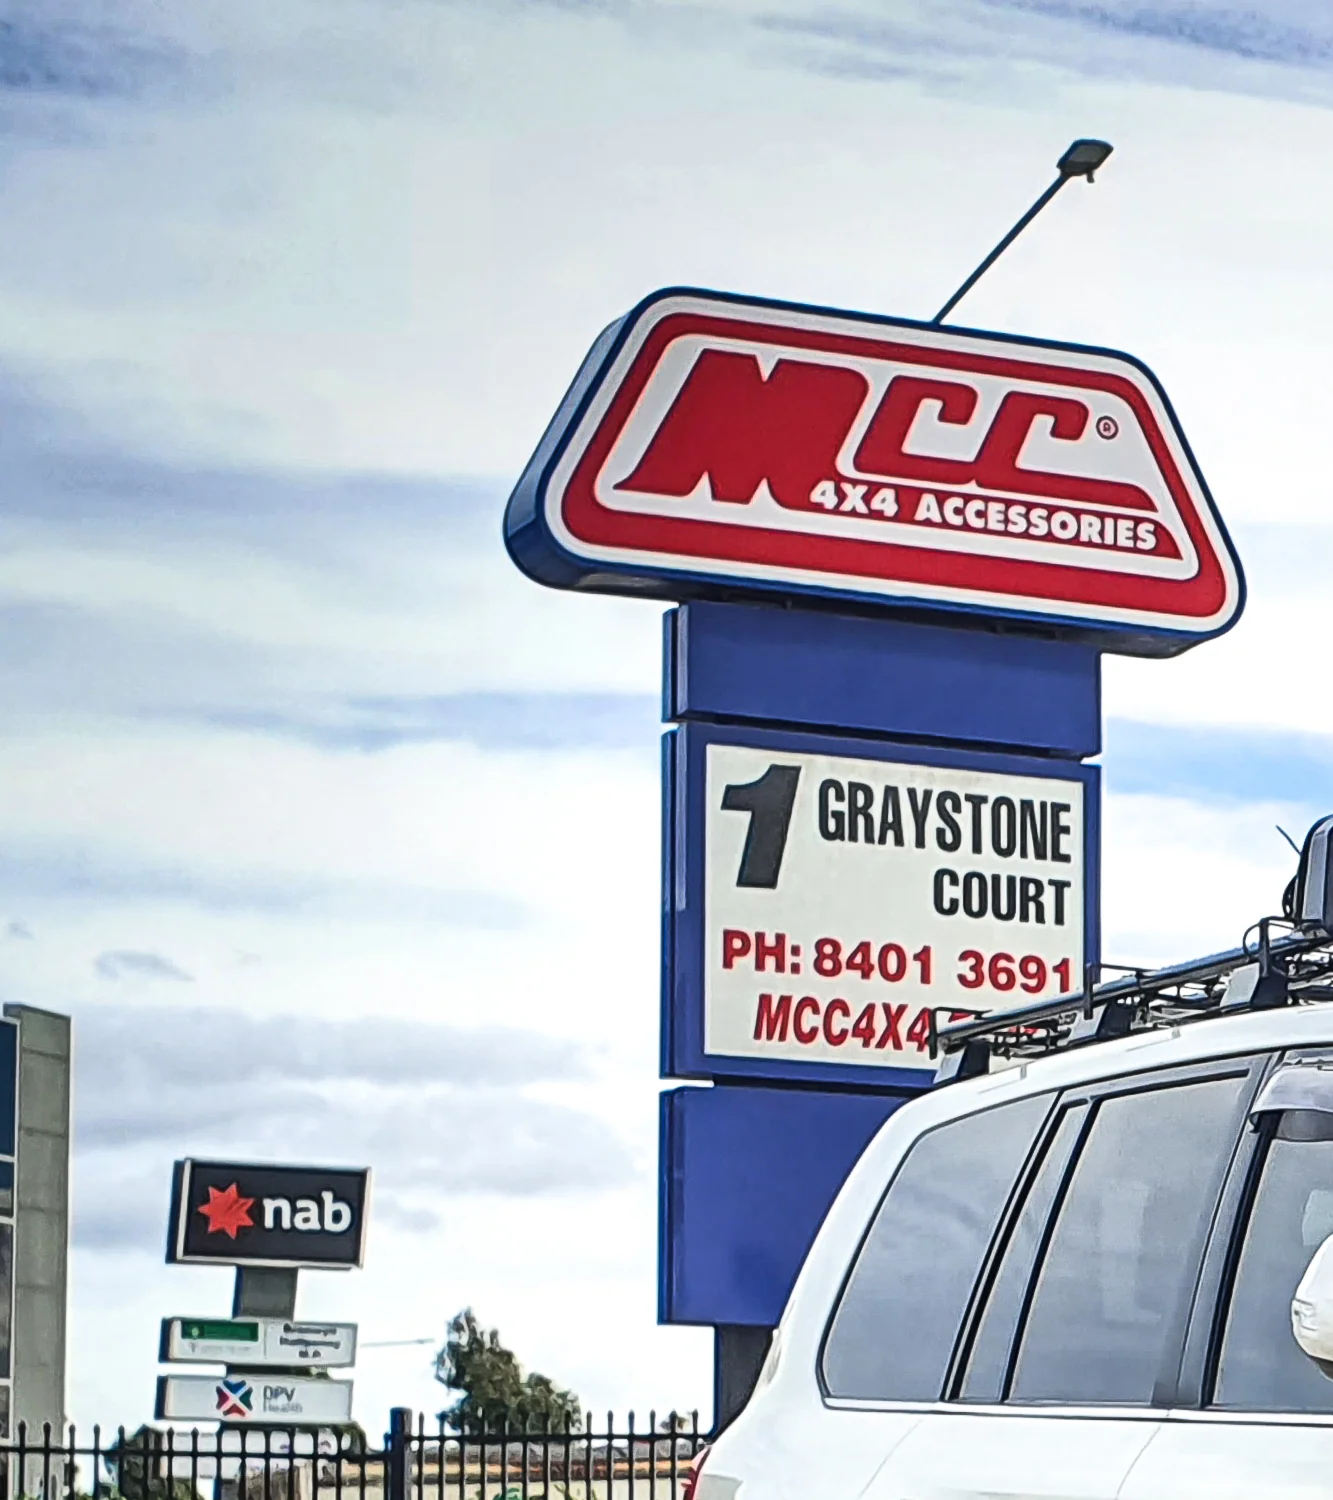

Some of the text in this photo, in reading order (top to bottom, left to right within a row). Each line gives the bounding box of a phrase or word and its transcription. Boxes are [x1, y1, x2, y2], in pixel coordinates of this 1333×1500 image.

[612, 347, 1158, 512] MCC
[809, 479, 1158, 551] 4X4 ACCESSORIES
[720, 763, 1072, 890] 1 GRAYSTONE
[933, 868, 1072, 926] COURT
[722, 929, 1072, 994] PH: 8401 3691
[263, 1191, 352, 1232] nab
